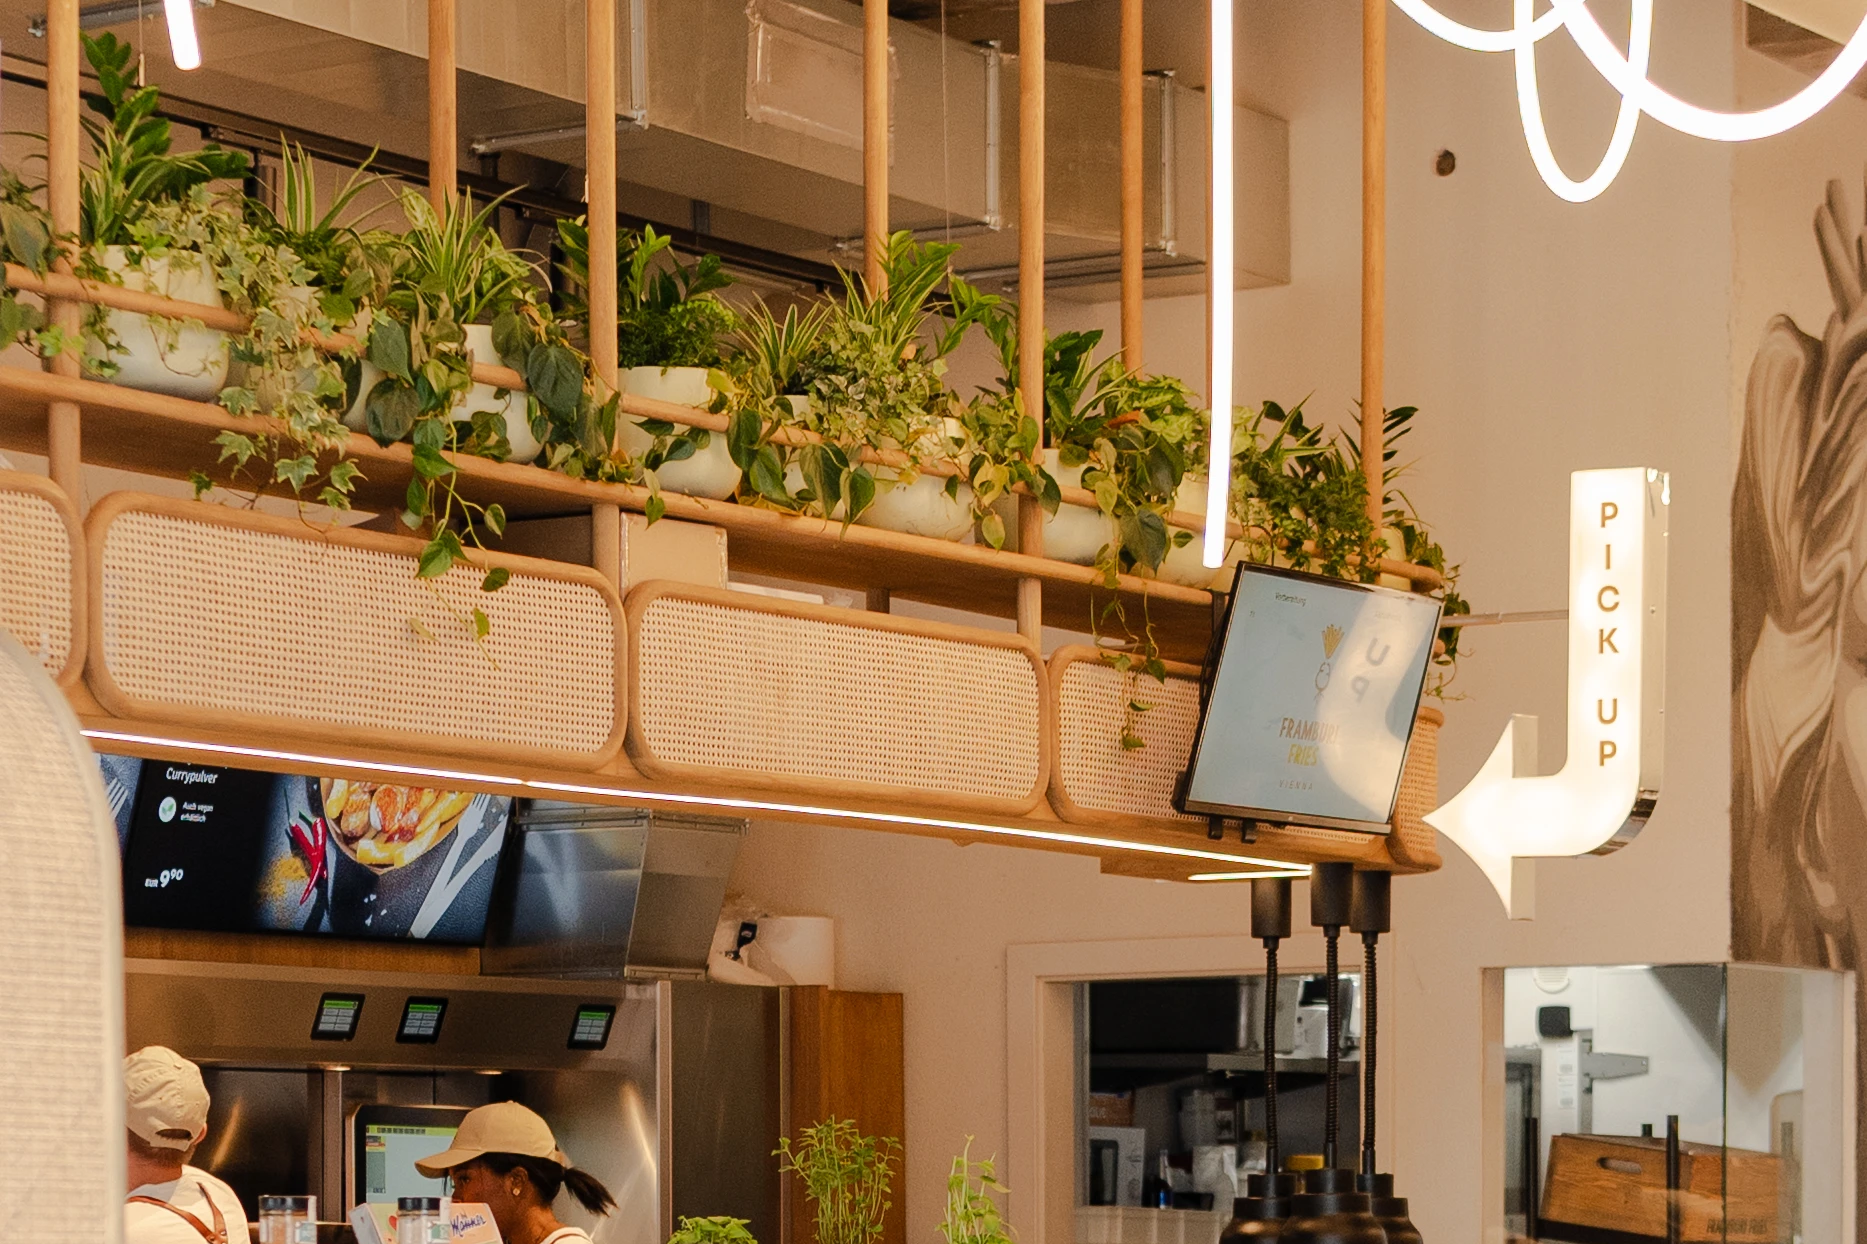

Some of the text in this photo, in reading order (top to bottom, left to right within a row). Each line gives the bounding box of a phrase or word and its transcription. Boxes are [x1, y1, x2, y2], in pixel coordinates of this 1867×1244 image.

[1596, 501, 1621, 767] PICK UP
[1287, 743, 1320, 767] FRIES
[166, 767, 218, 784] Currypulver
